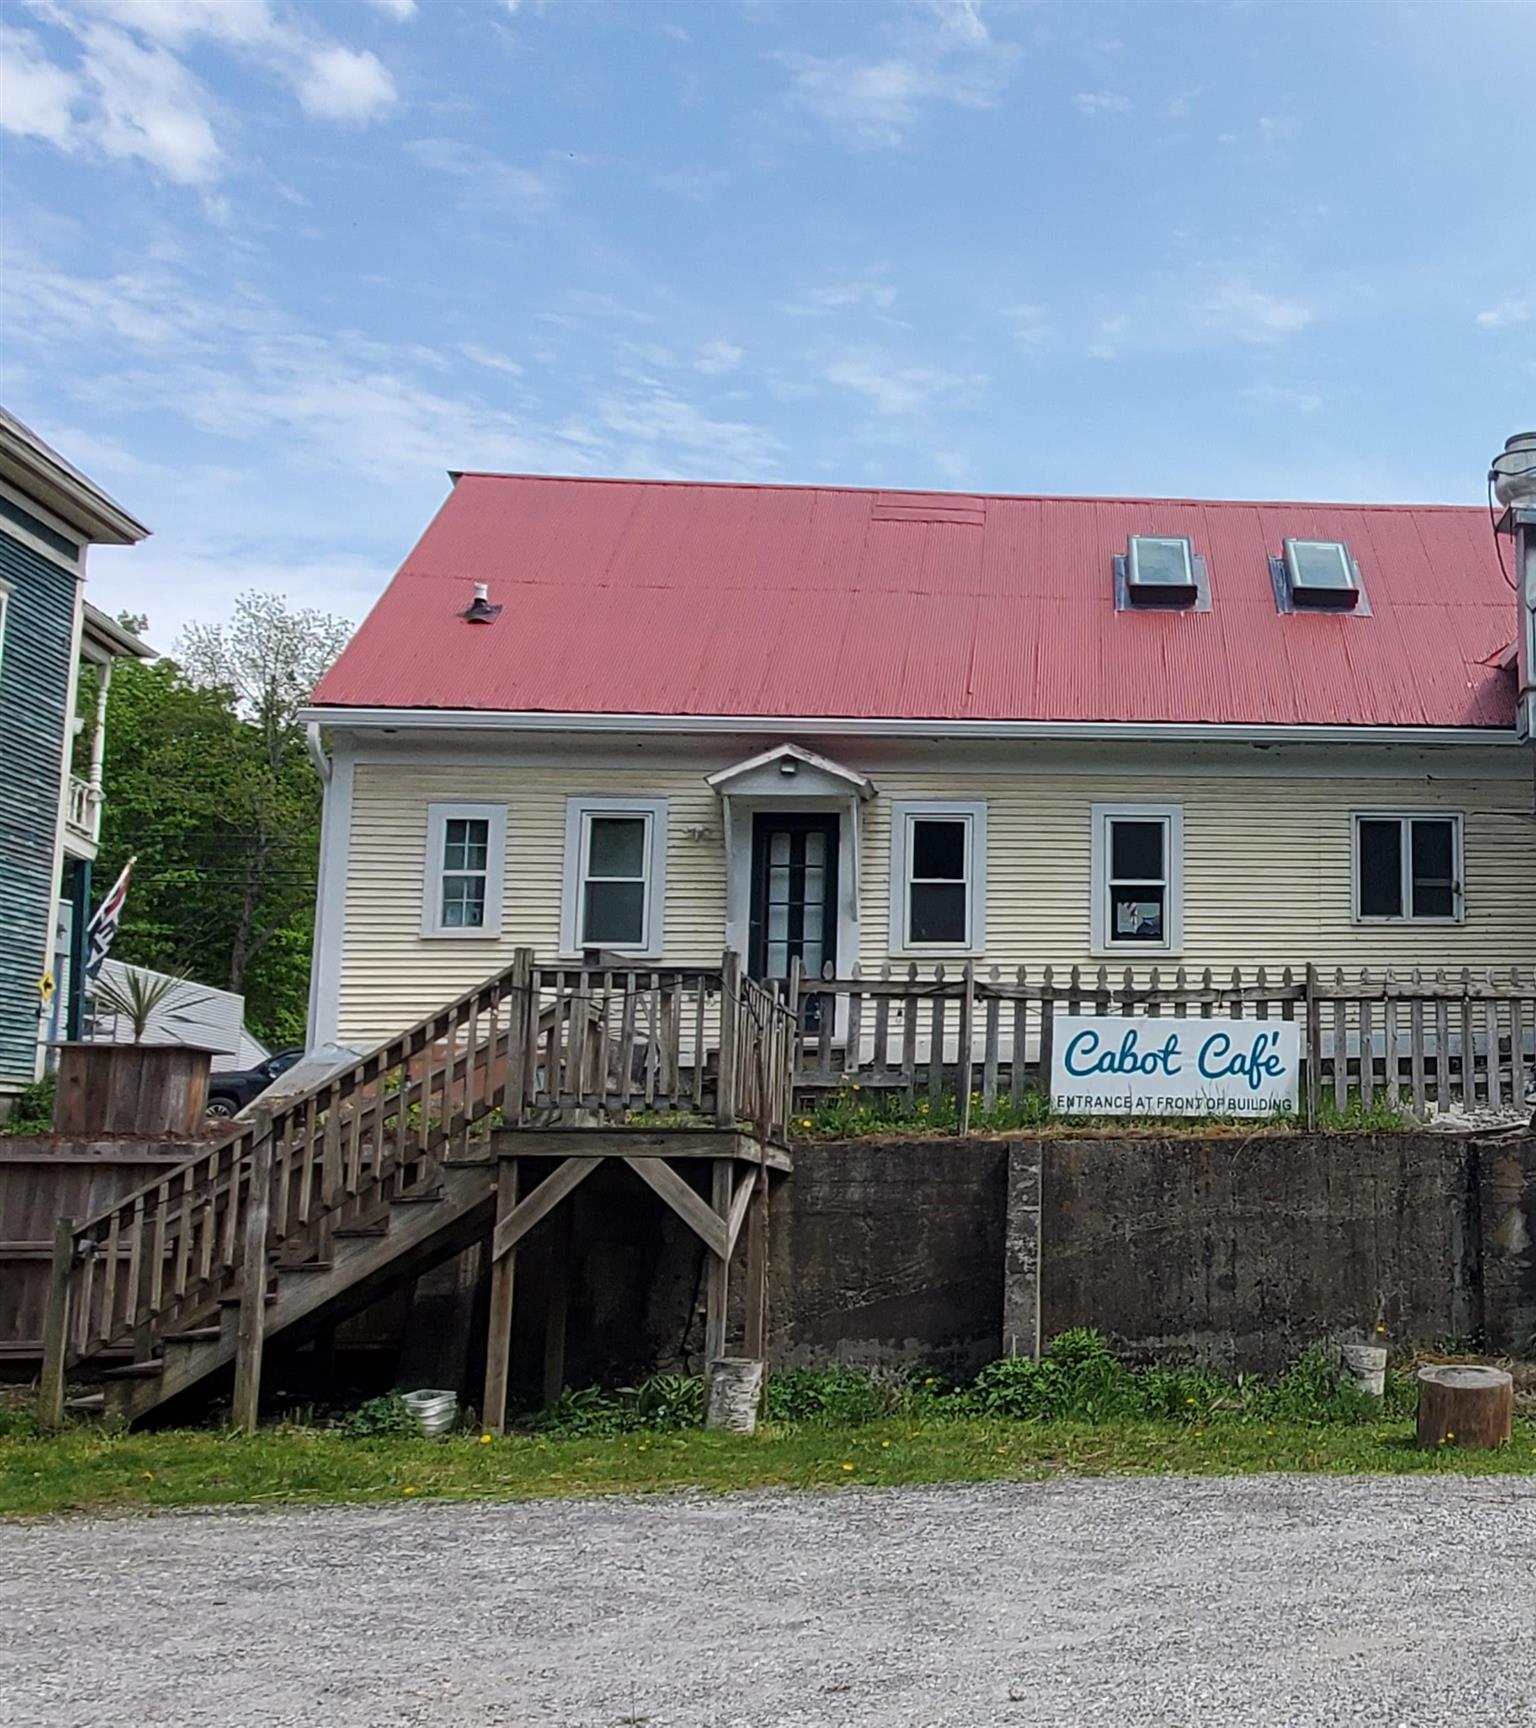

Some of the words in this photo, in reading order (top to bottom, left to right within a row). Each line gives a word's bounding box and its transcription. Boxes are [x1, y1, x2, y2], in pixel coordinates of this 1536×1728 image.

[1064, 1028, 1183, 1077] Cabot
[1197, 1030, 1286, 1090] Café
[1057, 1095, 1132, 1109] ENTRANCE
[1136, 1096, 1154, 1110] AT
[1157, 1096, 1203, 1110] FRONT
[1227, 1098, 1292, 1111] BUILDING
